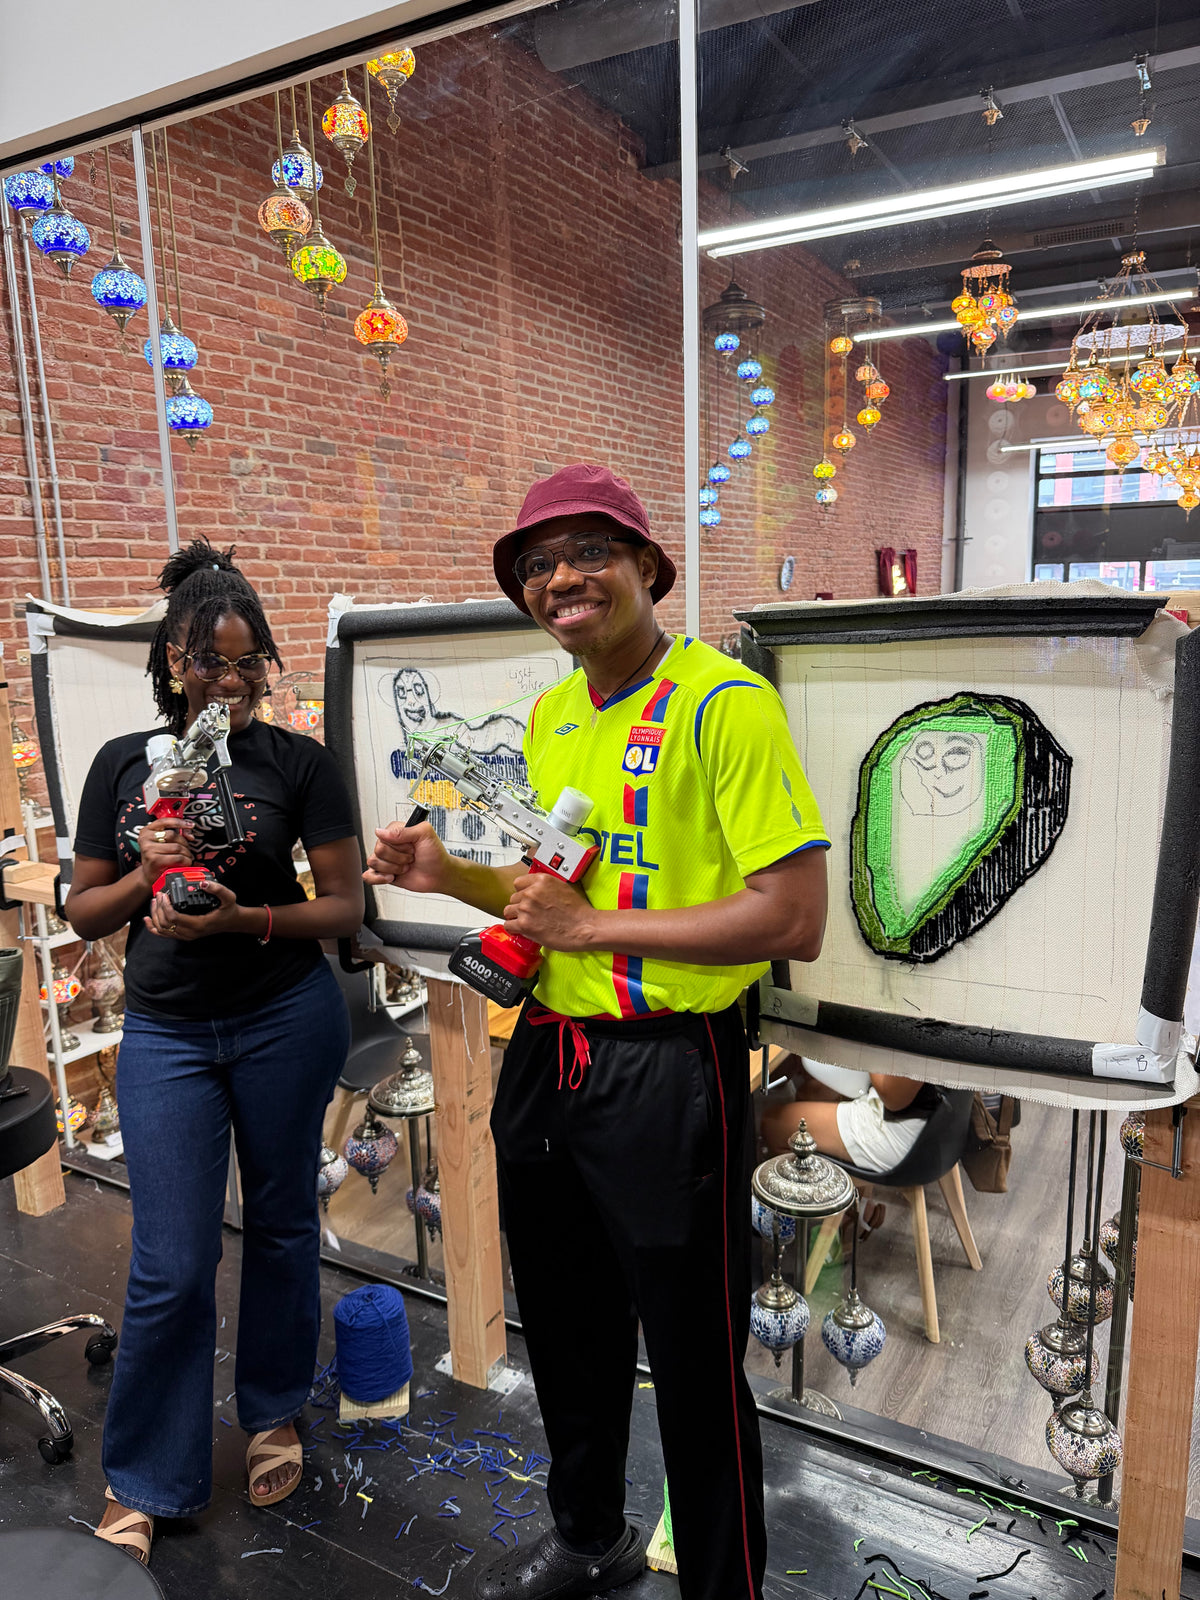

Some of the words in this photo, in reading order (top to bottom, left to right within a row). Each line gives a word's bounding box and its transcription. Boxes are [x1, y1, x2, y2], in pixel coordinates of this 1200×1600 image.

[629, 734, 661, 744] LYONNAIS
[631, 727, 665, 738] OLYMPIQUE
[625, 745, 655, 772] OL
[463, 956, 493, 979] 4000
